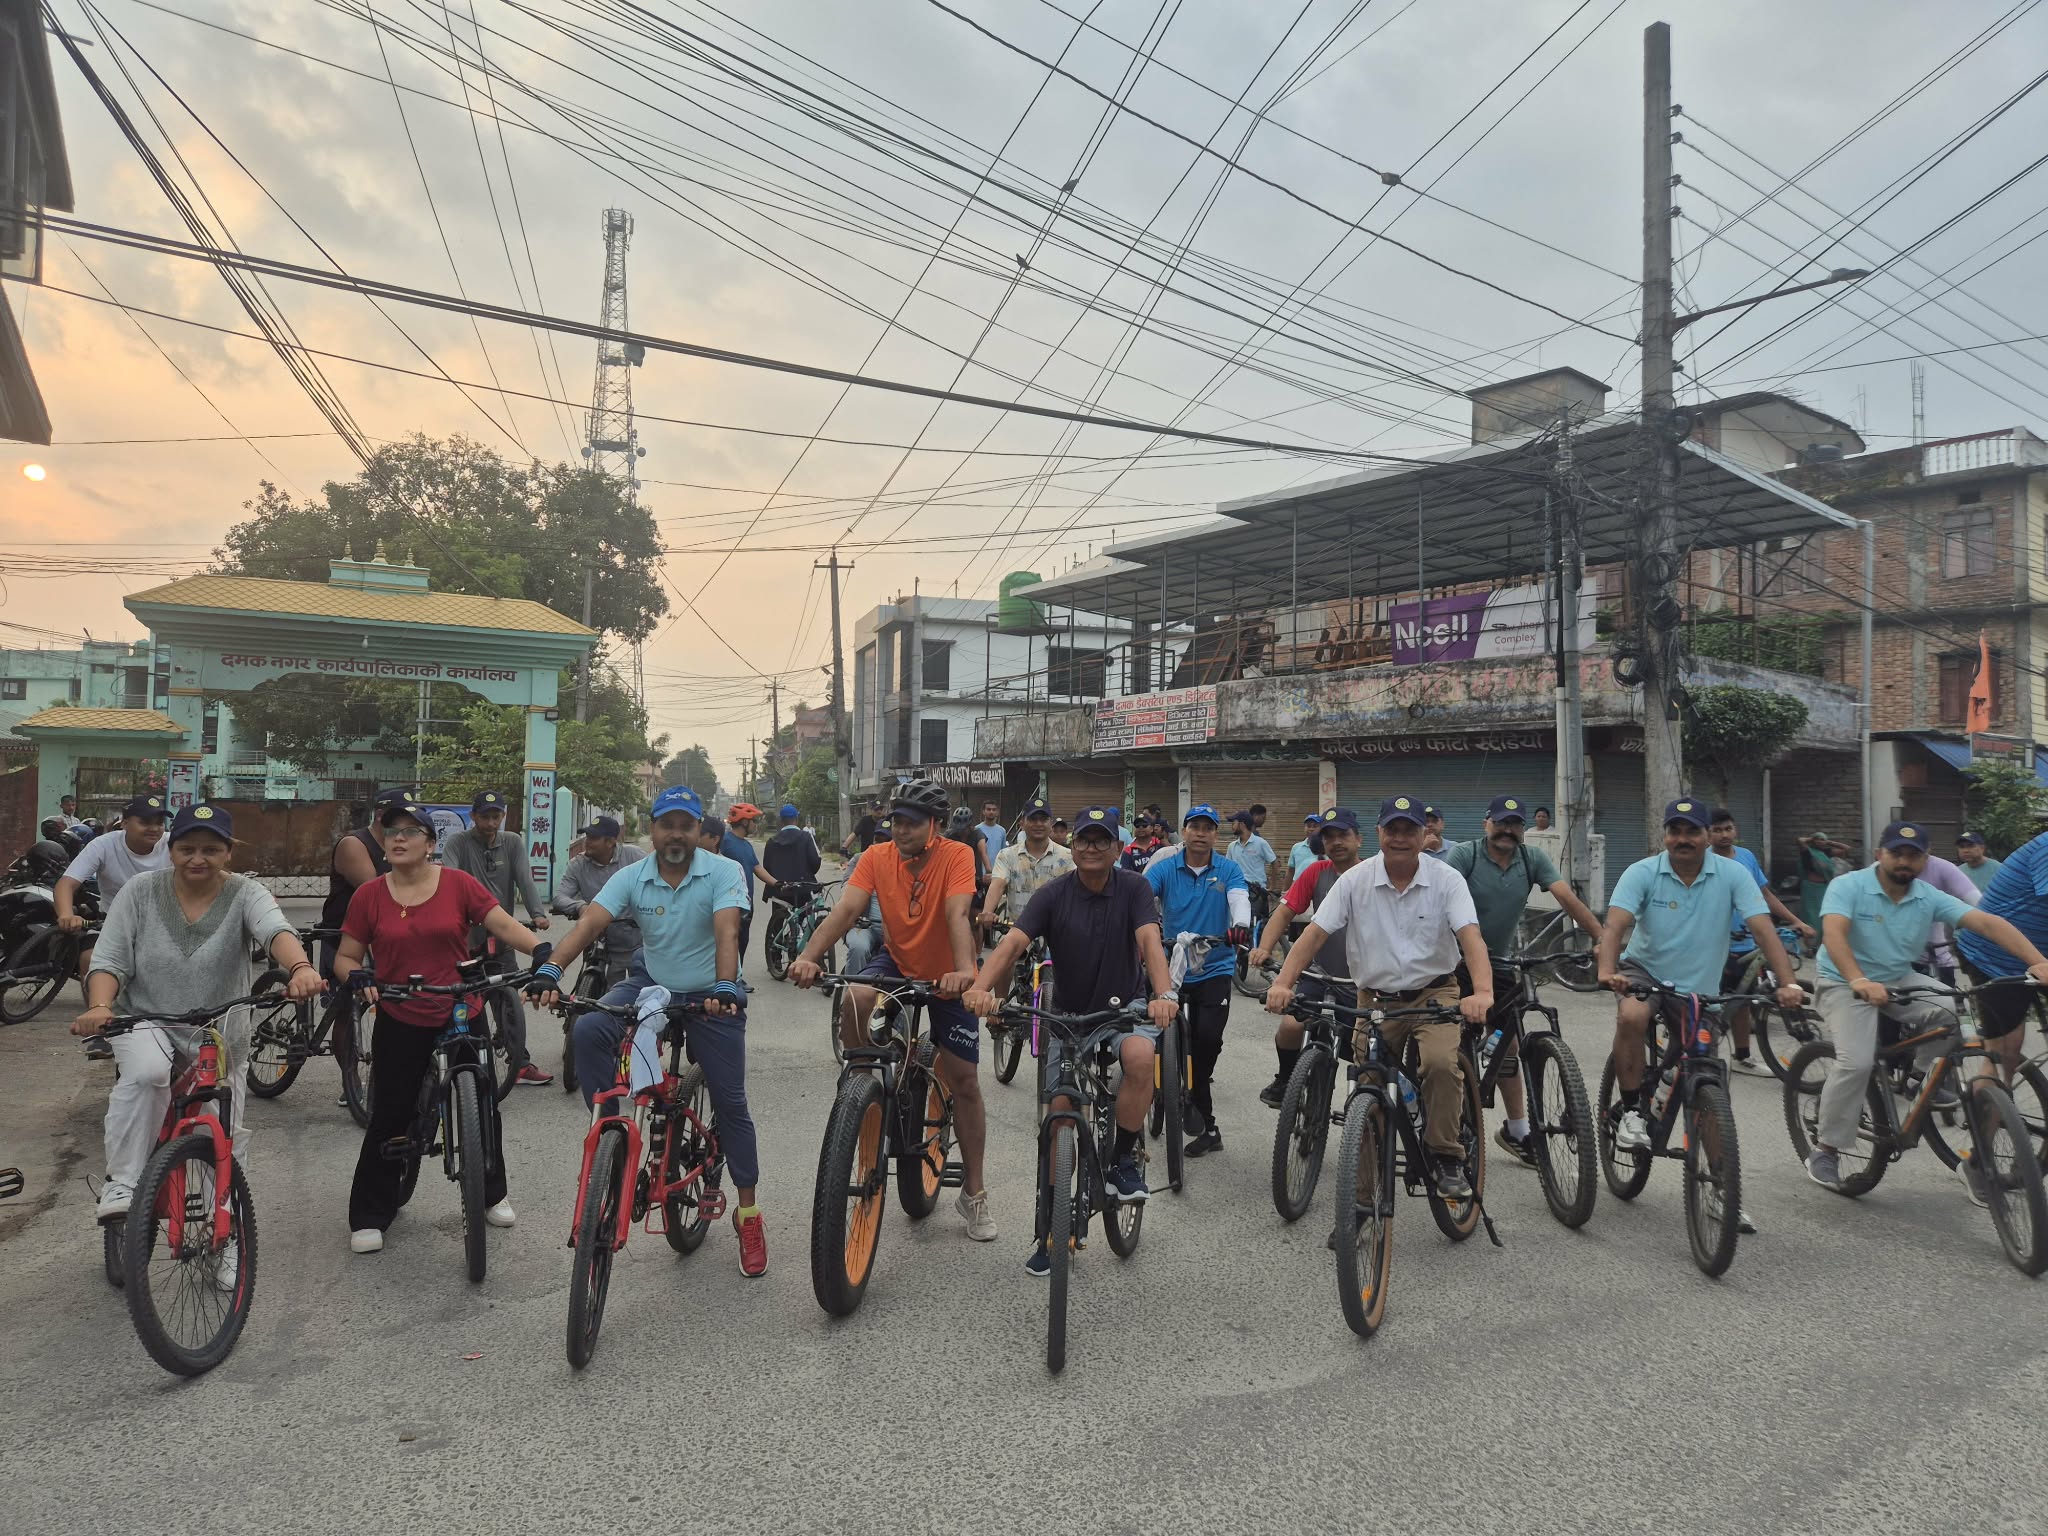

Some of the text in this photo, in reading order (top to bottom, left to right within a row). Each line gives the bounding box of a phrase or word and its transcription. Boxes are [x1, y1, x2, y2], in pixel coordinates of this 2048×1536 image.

[1395, 613, 1468, 650] Ncell
[1494, 633, 1536, 645] Complex
[220, 653, 518, 682] दमक नगर कार्यपालिकाको कार्यालय
[532, 776, 550, 788] Wel
[932, 766, 944, 784] HOT
[951, 766, 970, 784] TASTY
[970, 769, 1002, 784] RESTAURANT
